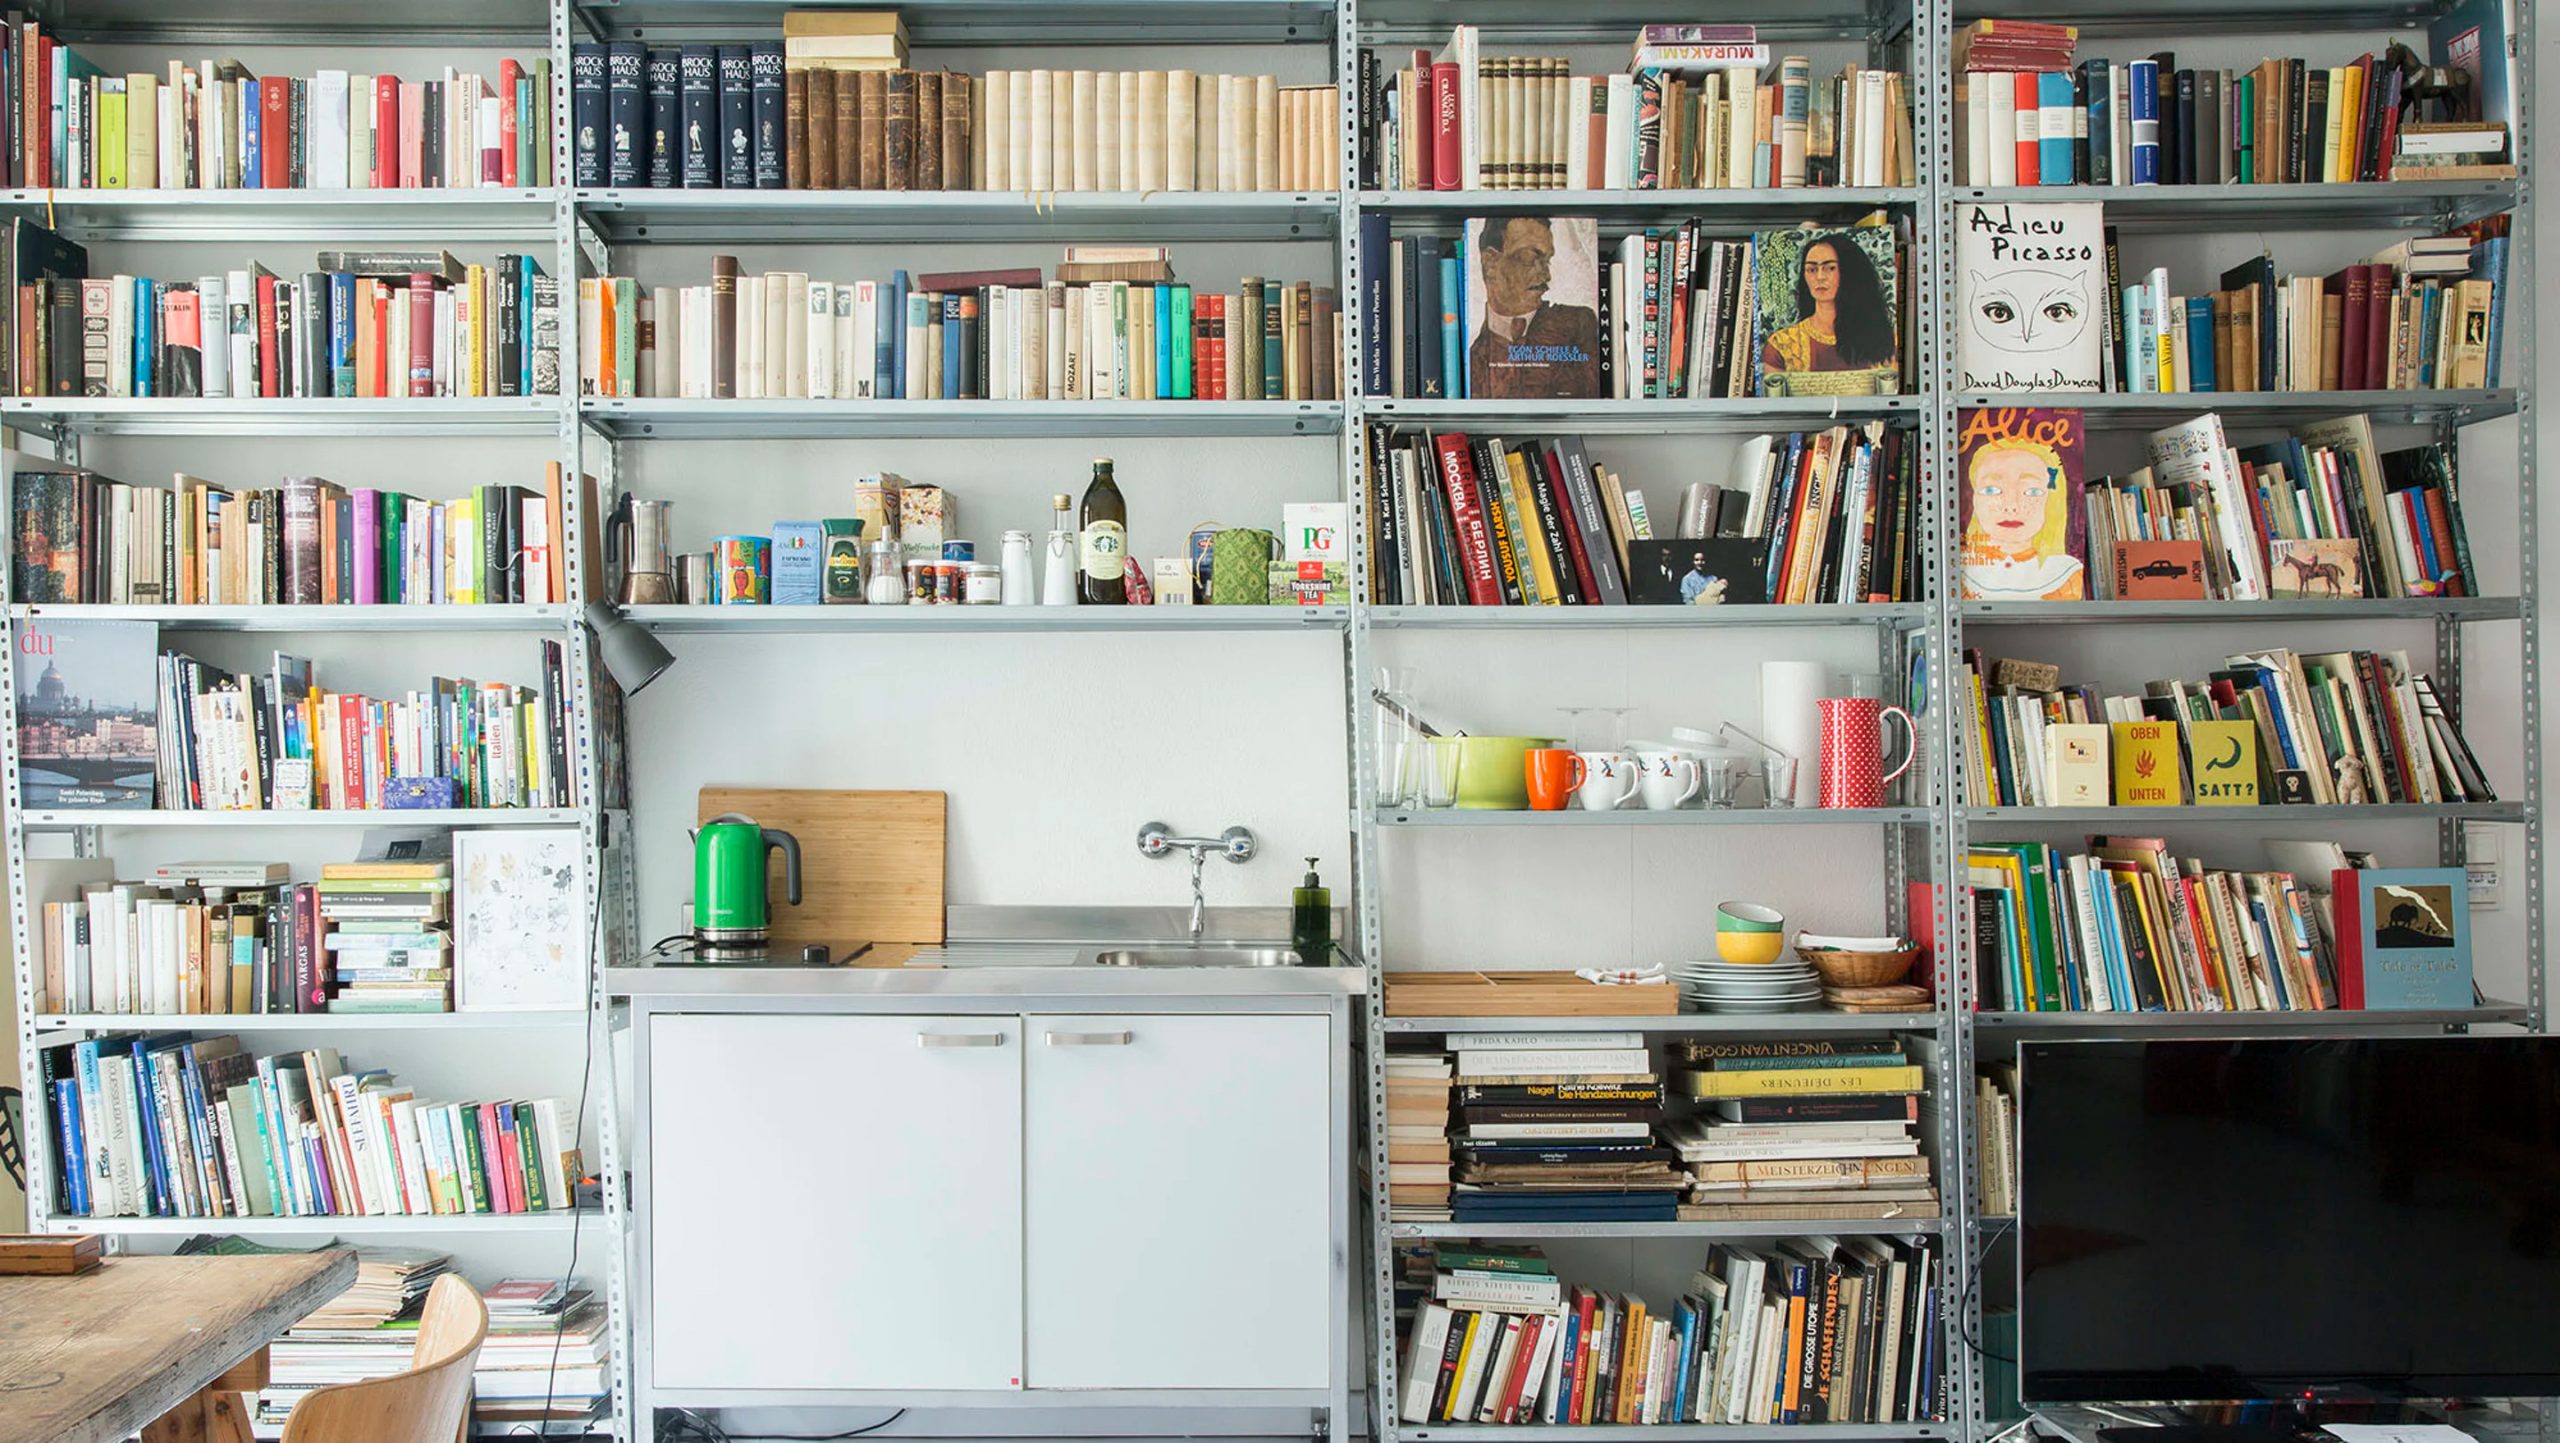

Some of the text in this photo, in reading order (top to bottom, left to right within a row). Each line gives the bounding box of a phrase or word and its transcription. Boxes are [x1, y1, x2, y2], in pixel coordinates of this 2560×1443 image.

[574, 55, 604, 67] BROCK
[609, 55, 641, 68] BROCK
[682, 55, 713, 69] BROCK
[722, 58, 750, 70] BROCK
[752, 54, 783, 66] BROCK
[1362, 53, 1370, 77] PABLO
[1658, 47, 1753, 60] MURAKAMI
[575, 66, 602, 77] HAUS
[612, 66, 639, 77] HAUS
[648, 62, 678, 74] BROCK
[650, 72, 675, 82] HAUS
[684, 67, 711, 77] HAUS
[725, 69, 750, 79] HAUS
[754, 63, 781, 74] HAUS
[1362, 79, 1370, 113] PICASSO
[1441, 78, 1449, 118] CRANACH
[1970, 205, 2064, 235] Adieu
[1678, 231, 1689, 288] BASQUIAT
[1991, 237, 2092, 261] Picasso
[1646, 243, 1657, 299] DRESSED
[1662, 244, 1671, 288] FAUVISMUS
[2107, 245, 2120, 284] GENESIS
[859, 285, 872, 302] IV
[1601, 288, 1610, 371] TAMAYO
[2101, 287, 2111, 348] STUDIOFILMCLUB
[1659, 307, 1668, 380] EXPRESSIONISMUS
[1733, 321, 1749, 383] Kunstausstellung
[1742, 289, 1750, 306] DDR
[1508, 353, 1589, 361] ARTHUR ROESSLER
[1067, 352, 1076, 392] MOZART
[1960, 371, 2003, 391] David
[2000, 371, 2053, 392] Douglas
[1958, 407, 2074, 454] Alice
[1376, 428, 1392, 540] Brix Karl Schmidt-Rottluff
[1394, 452, 1404, 506] SYMBOLISMUS
[1444, 451, 1465, 511] МОСКВА
[1458, 449, 1478, 508] BERLIN
[1536, 482, 1563, 552] Magie der Zahl
[1303, 527, 1330, 550] PG
[1400, 525, 1409, 569] IDEALISMUS
[1471, 520, 1492, 581] БЕРЛИН
[1490, 501, 1516, 583] YOUSUF KARSH
[1461, 523, 1479, 583] MOSKAU
[2192, 560, 2202, 582] NICHT
[1291, 581, 1332, 592] YORKSHIRE
[1304, 591, 1318, 600] TEA
[20, 625, 54, 655] du
[490, 725, 501, 759] Italien
[2131, 727, 2160, 740] OBEN
[204, 738, 216, 792] Brandenburg
[2129, 788, 2165, 800] UNTEN
[2199, 783, 2253, 796] SATT?
[298, 946, 308, 986] VARGAS
[2380, 959, 2457, 973] Tale of Tales
[1473, 1037, 1537, 1045] FRIDA KAHLO
[1690, 1042, 1834, 1060] VINCENT VAN GOGH
[1527, 1086, 1554, 1097] Nagel
[1761, 1077, 1862, 1088] LES DÉJEUNERS
[1558, 1090, 1657, 1101] Die Handzeichnungen
[342, 1083, 366, 1151] SEEFAHRT
[1756, 1161, 1915, 1177] MEISTERZEICHNNGEN
[1820, 1273, 1839, 1381] SCHAFFENDEN
[1803, 1302, 1819, 1388] DIE GROSSE UTOPIE
[1937, 1375, 1947, 1415] Fritz Erpel
